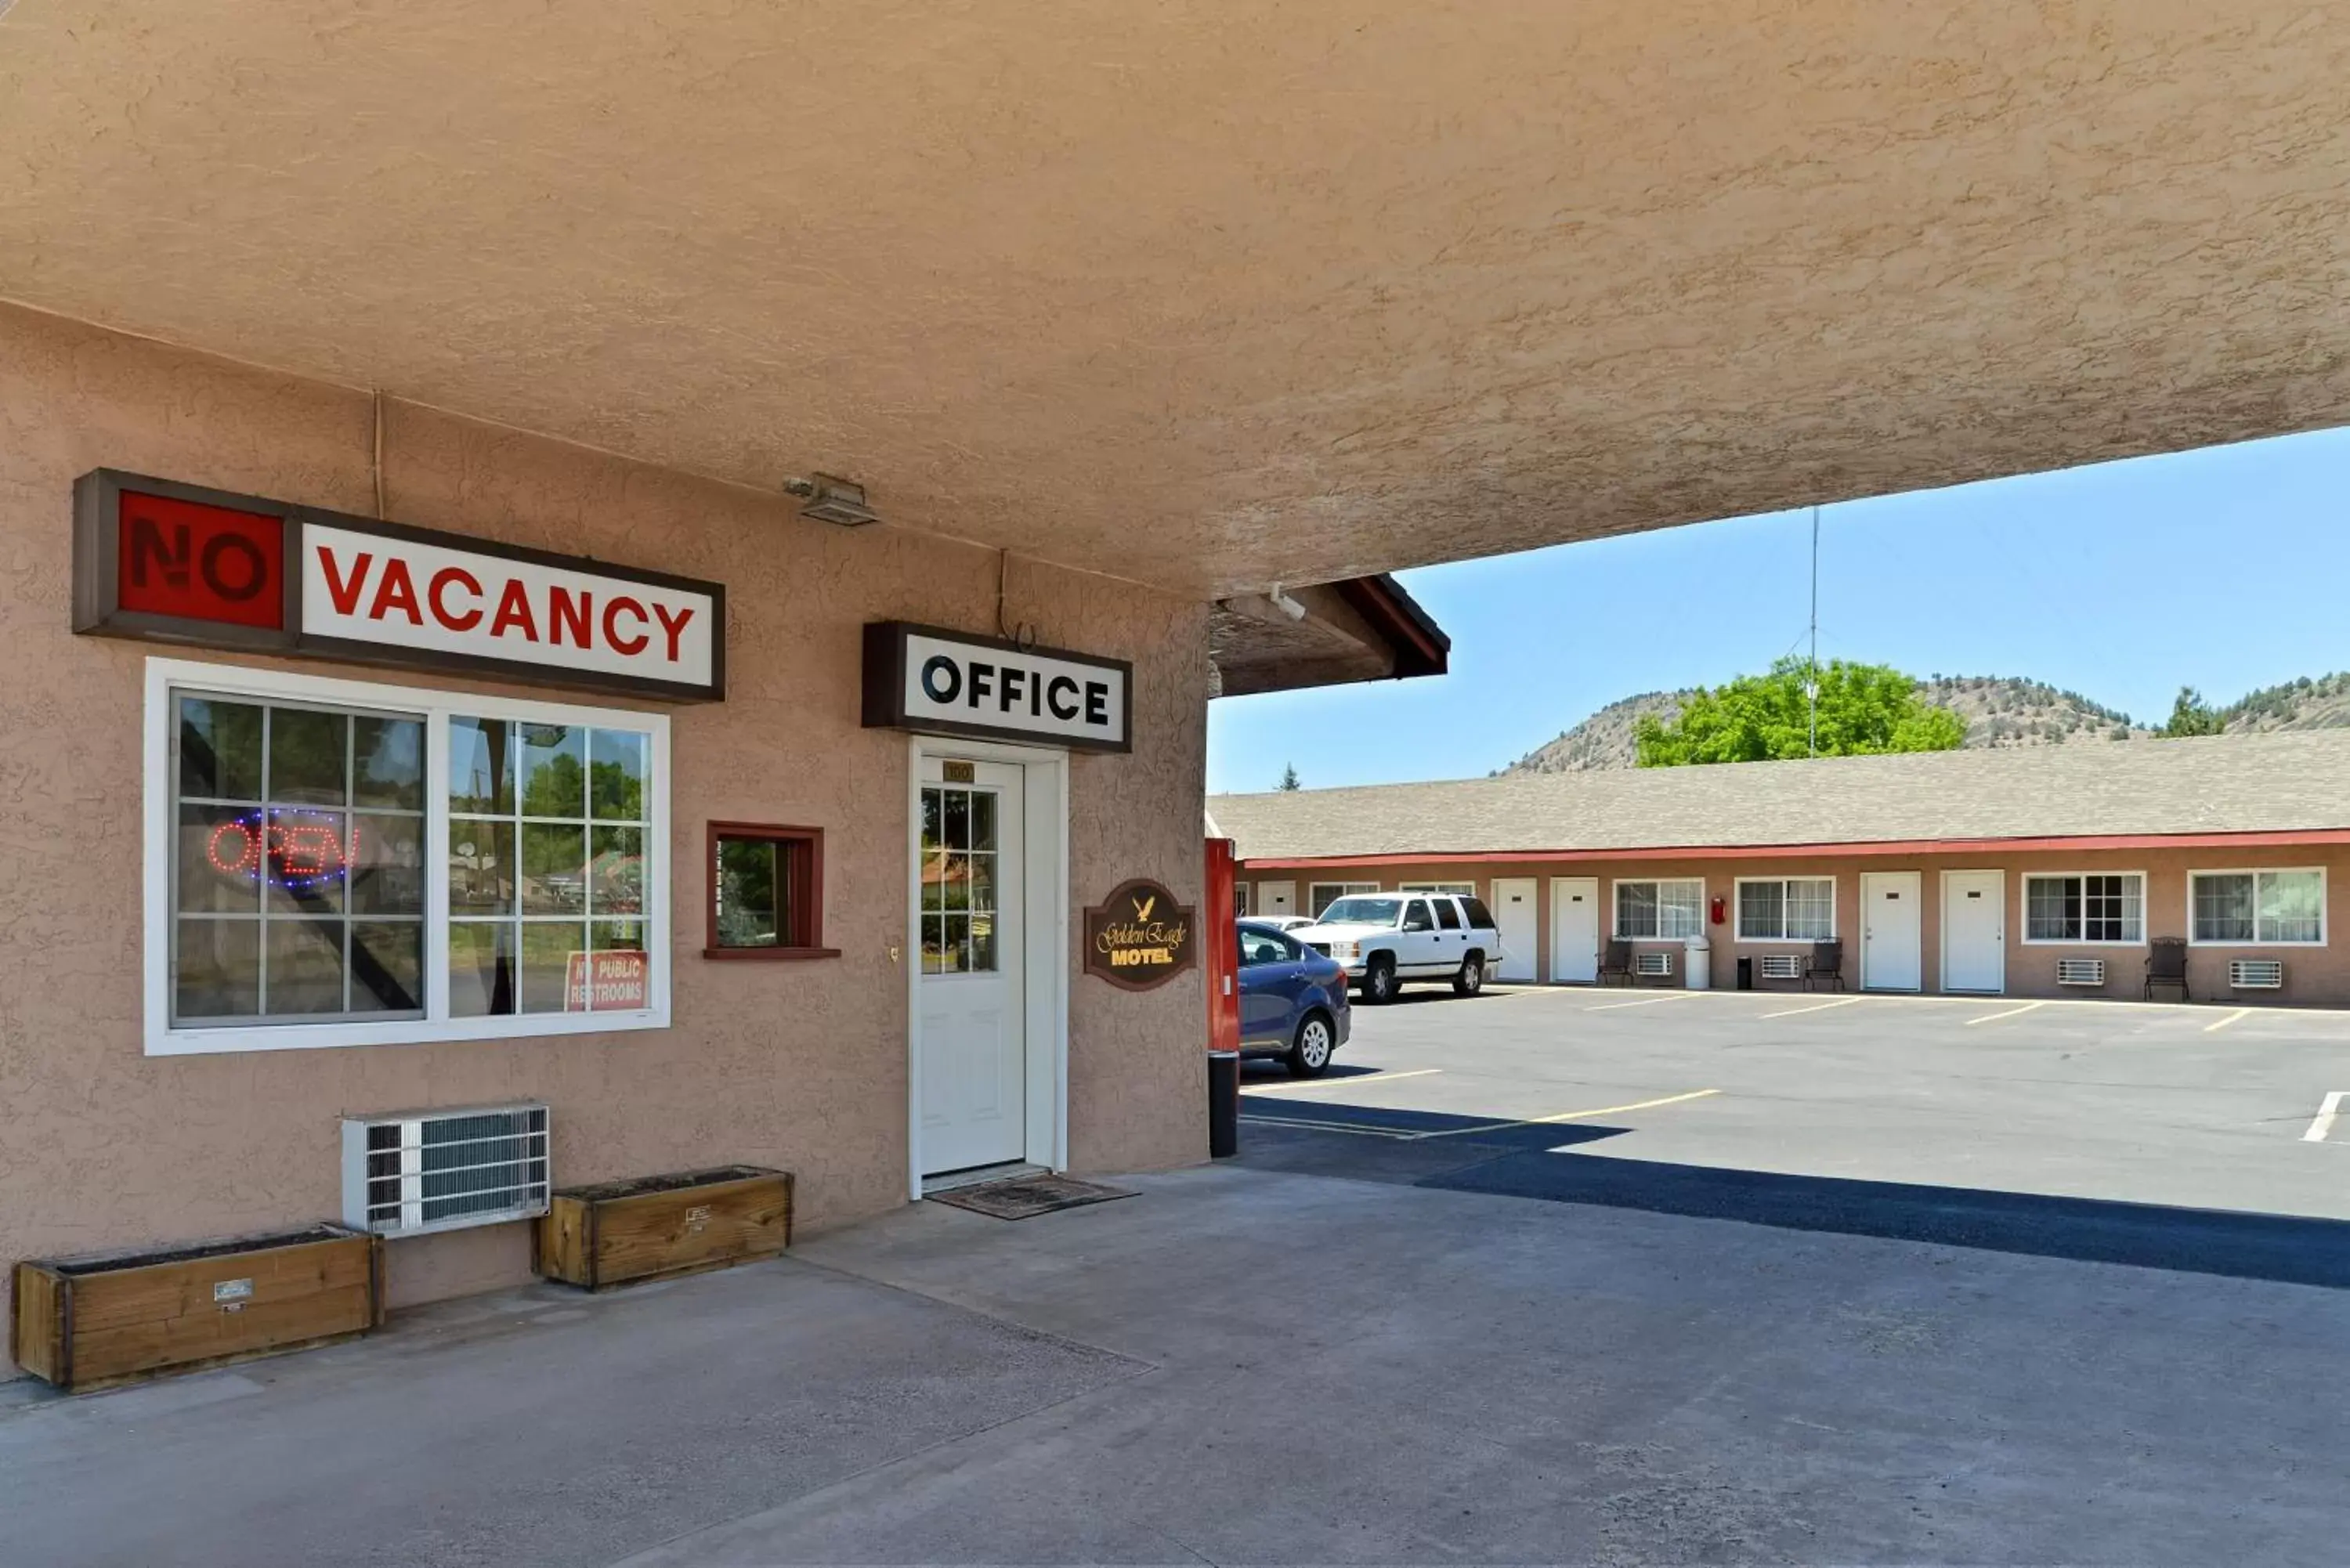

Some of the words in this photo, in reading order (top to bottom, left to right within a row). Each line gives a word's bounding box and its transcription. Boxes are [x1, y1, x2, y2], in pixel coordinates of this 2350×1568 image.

[132, 518, 267, 602] NO
[316, 545, 696, 663] VACANCY
[921, 655, 1108, 725] OFFICE
[208, 822, 363, 876] OPEN
[598, 959, 641, 979] PUBLIC
[1112, 948, 1173, 966] MOTEL
